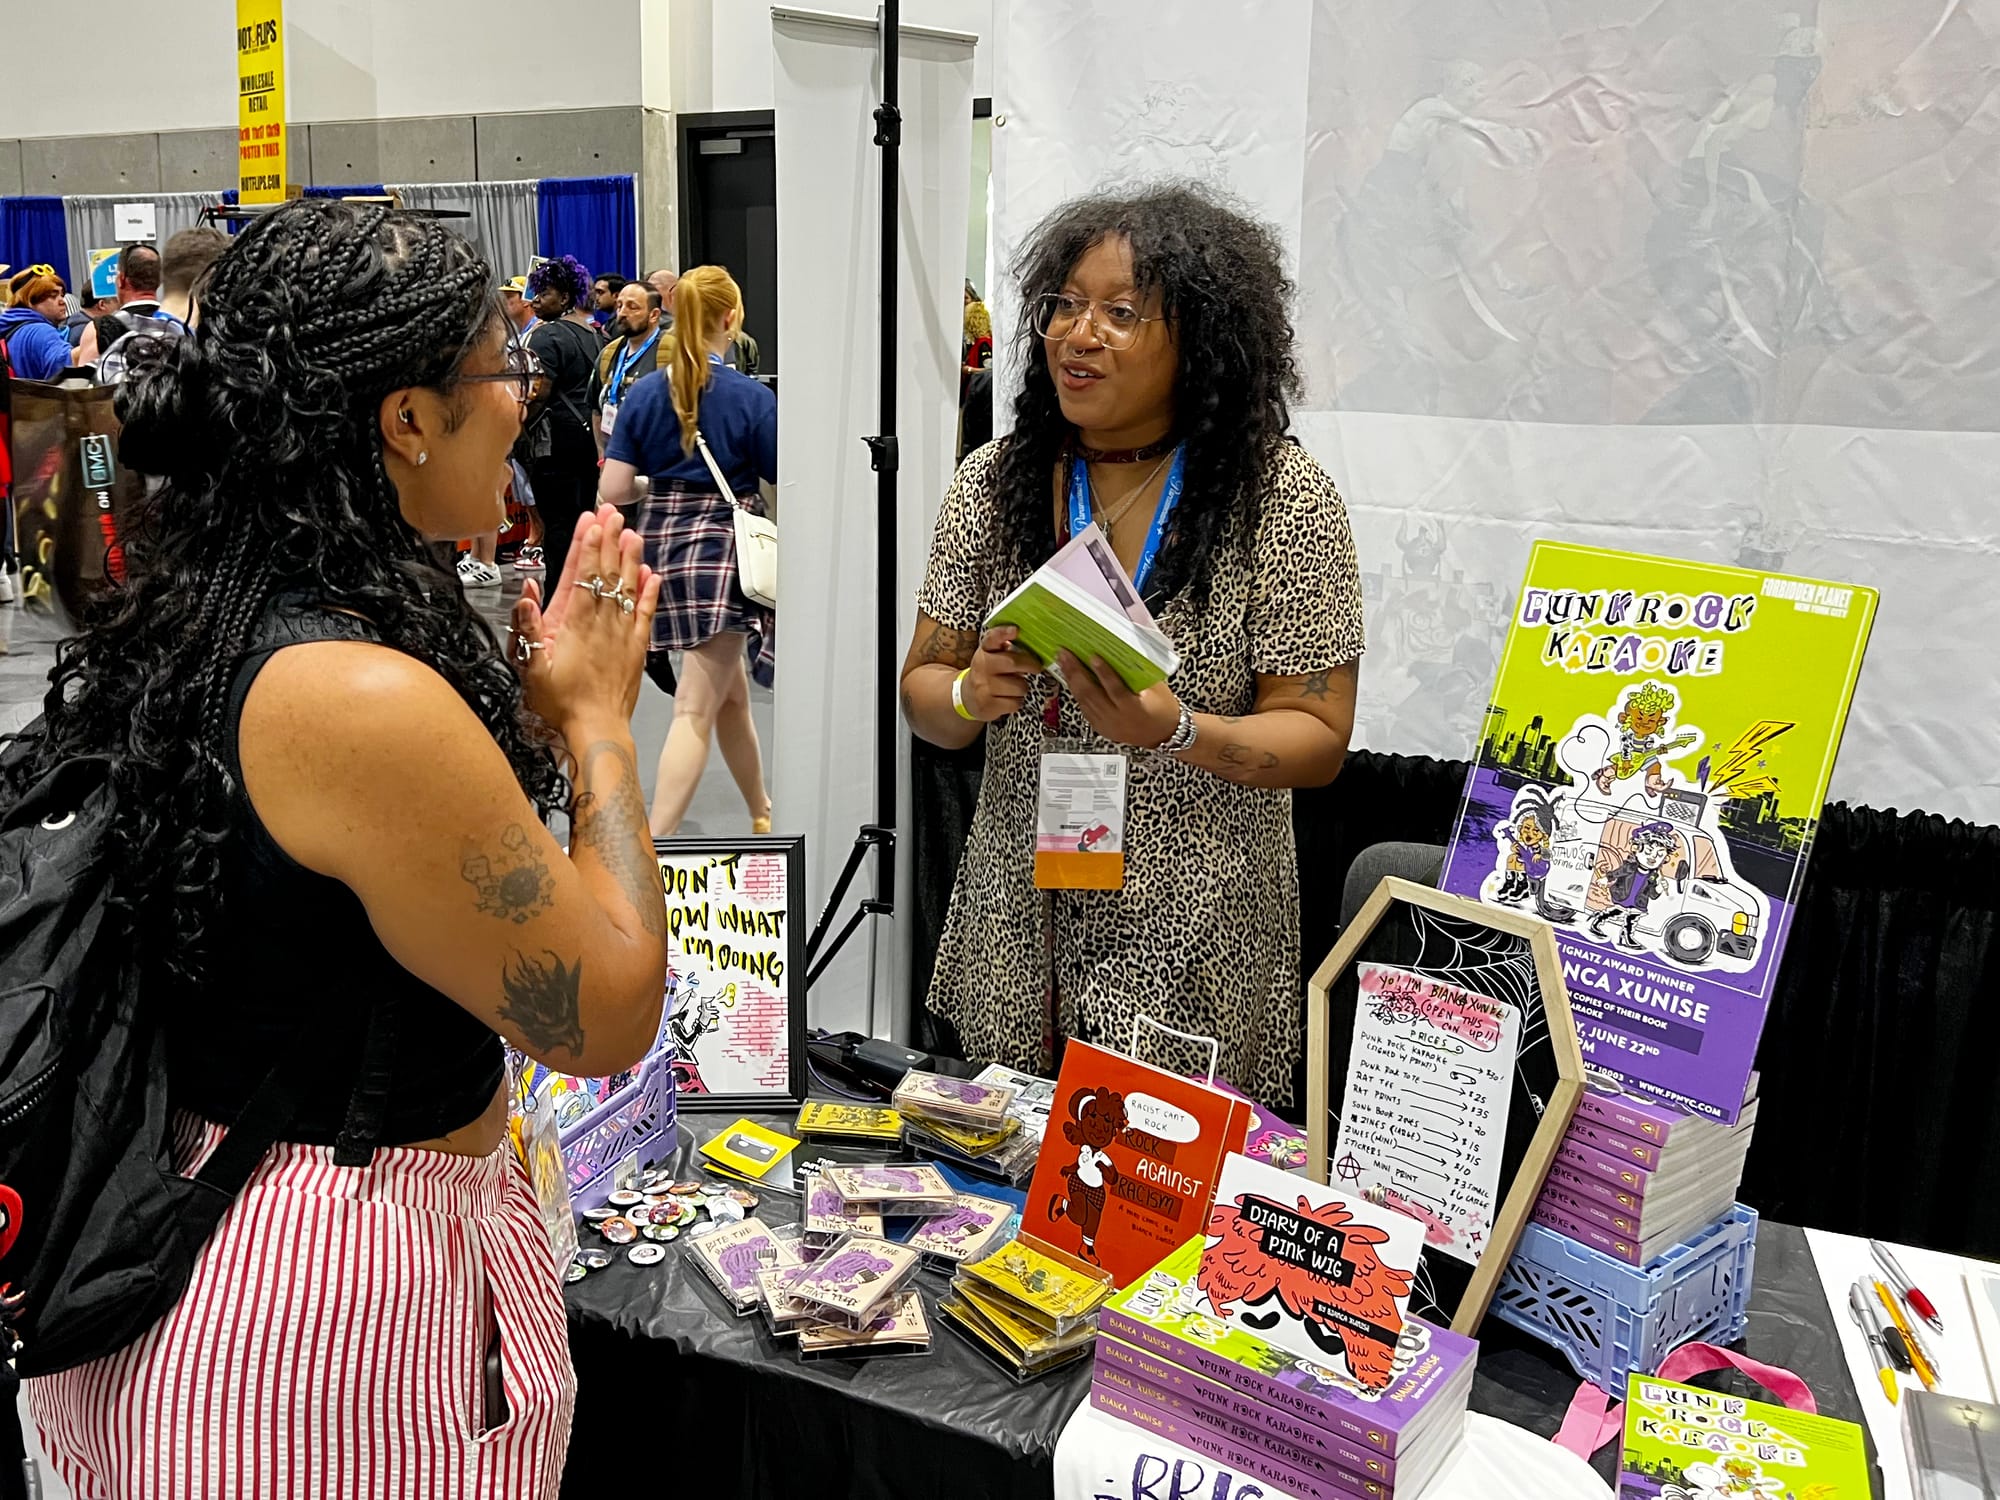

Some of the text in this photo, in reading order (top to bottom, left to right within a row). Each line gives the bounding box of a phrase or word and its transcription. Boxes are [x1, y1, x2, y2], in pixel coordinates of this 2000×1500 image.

[240, 70, 274, 91] WHOLESALE
[249, 95, 268, 112] RETAIL
[1523, 588, 1755, 631] PUNK ROCK
[1544, 630, 1722, 674] KARAOKE
[661, 853, 742, 898] DON'T
[1553, 859, 1573, 869] OFING
[670, 902, 786, 940] OW WHAT
[684, 938, 784, 987] I'M DOING
[1562, 944, 1602, 964] IGNATZ
[1602, 957, 1645, 977] AWARD
[1646, 970, 1696, 994] WINNER
[1405, 977, 1422, 992] I'M
[1563, 960, 1710, 1024] NCA XUNISE
[1426, 1003, 1484, 1028] OPEN THIS
[1573, 992, 1603, 1007] COPIES
[1603, 1002, 1616, 1012] OF
[1616, 1006, 1641, 1021] THEIR
[1642, 1015, 1668, 1030] BOOK
[1361, 1031, 1382, 1044] PUNK
[1410, 1029, 1448, 1047] PRICES
[1588, 1027, 1628, 1048] JUNE
[1628, 1040, 1660, 1056] 22ND
[1353, 1083, 1368, 1096] RAT
[1356, 1071, 1374, 1082] RAT
[1402, 1071, 1420, 1084] TOTE
[1468, 1090, 1487, 1104] $25
[1583, 1061, 1722, 1117] NY 10003 WWW.FPNYC.COM
[1131, 1099, 1160, 1115] RACIST
[1375, 1106, 1394, 1118] BOOK
[1144, 1117, 1168, 1133] ROCK
[1360, 1116, 1386, 1130] ZINES
[1124, 1127, 1160, 1156] ROCK
[1344, 1137, 1381, 1157] STICKERS
[1136, 1158, 1203, 1198] AGAINST
[1373, 1159, 1391, 1172] MINI
[1395, 1168, 1419, 1183] PRINT
[1454, 1162, 1471, 1176] $10
[1118, 1177, 1174, 1215] RACISM
[733, 1227, 752, 1238] THE
[1250, 1205, 1339, 1253] DIARY OF A
[1269, 1236, 1343, 1278] PINK WIG
[1109, 1317, 1137, 1336] BIANCA
[1142, 1331, 1172, 1352] XUNISE
[1204, 1359, 1231, 1379] PUNK
[1235, 1373, 1263, 1393] ROCK
[1267, 1386, 1317, 1417] KARAOKE
[1105, 1345, 1134, 1364] BIANCA
[1138, 1359, 1169, 1380] XUNISE
[1201, 1388, 1229, 1407] PUNK
[1232, 1402, 1261, 1421] ROCK
[1266, 1415, 1315, 1445] KARAOKE
[1643, 1385, 1744, 1415] PUNK
[1104, 1369, 1313, 1467] BIANCA XUNISE PUNK ROCK KARAOKE
[1671, 1408, 1768, 1438] ROCK
[1100, 1394, 1310, 1493] BIANCA XUNISE PUNK ROCK KARAOKE
[1642, 1419, 1801, 1463] KARAOKE
